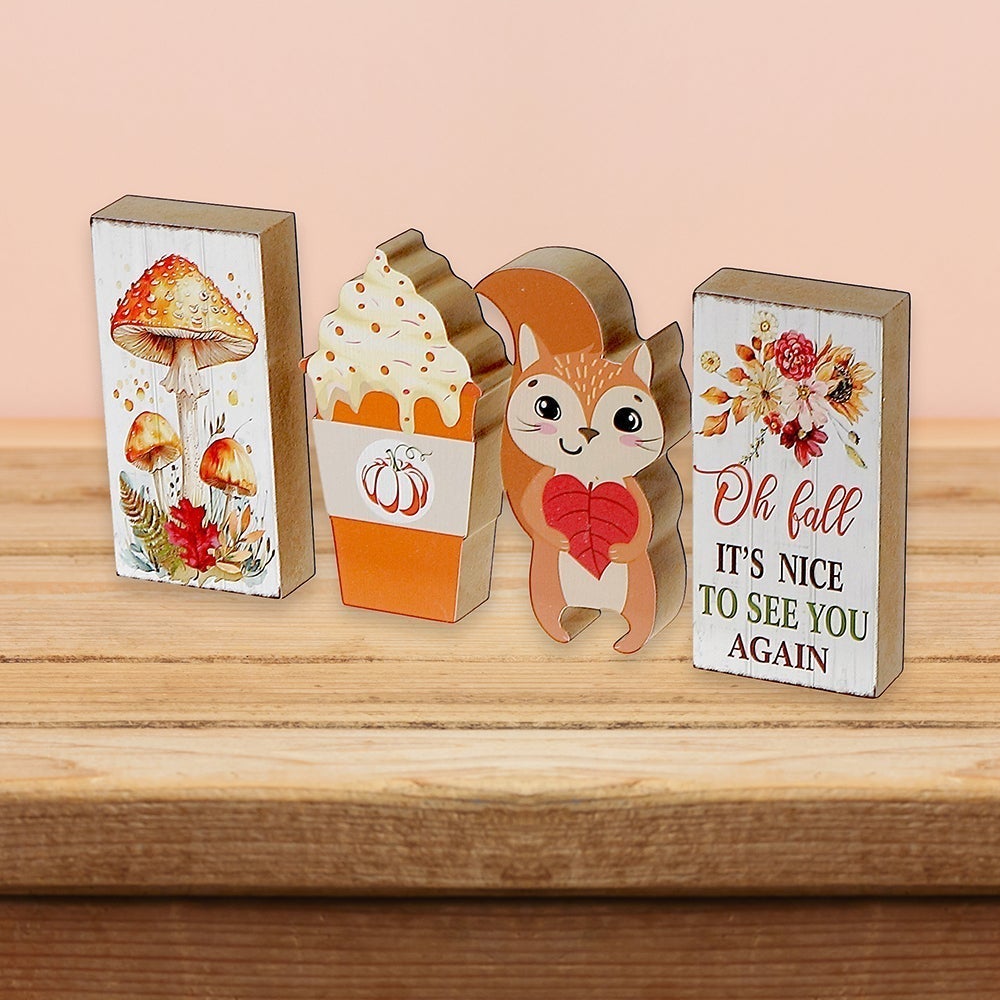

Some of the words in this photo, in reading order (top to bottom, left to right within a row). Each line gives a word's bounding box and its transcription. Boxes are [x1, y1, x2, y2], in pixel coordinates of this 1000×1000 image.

[693, 463, 778, 526] Oh
[787, 479, 863, 540] fall
[715, 542, 764, 580] IT'S
[778, 552, 844, 593] NICE
[698, 583, 738, 620] TO
[747, 591, 799, 630] SEE
[806, 601, 869, 642] YOU
[727, 632, 829, 674] AGAIN
